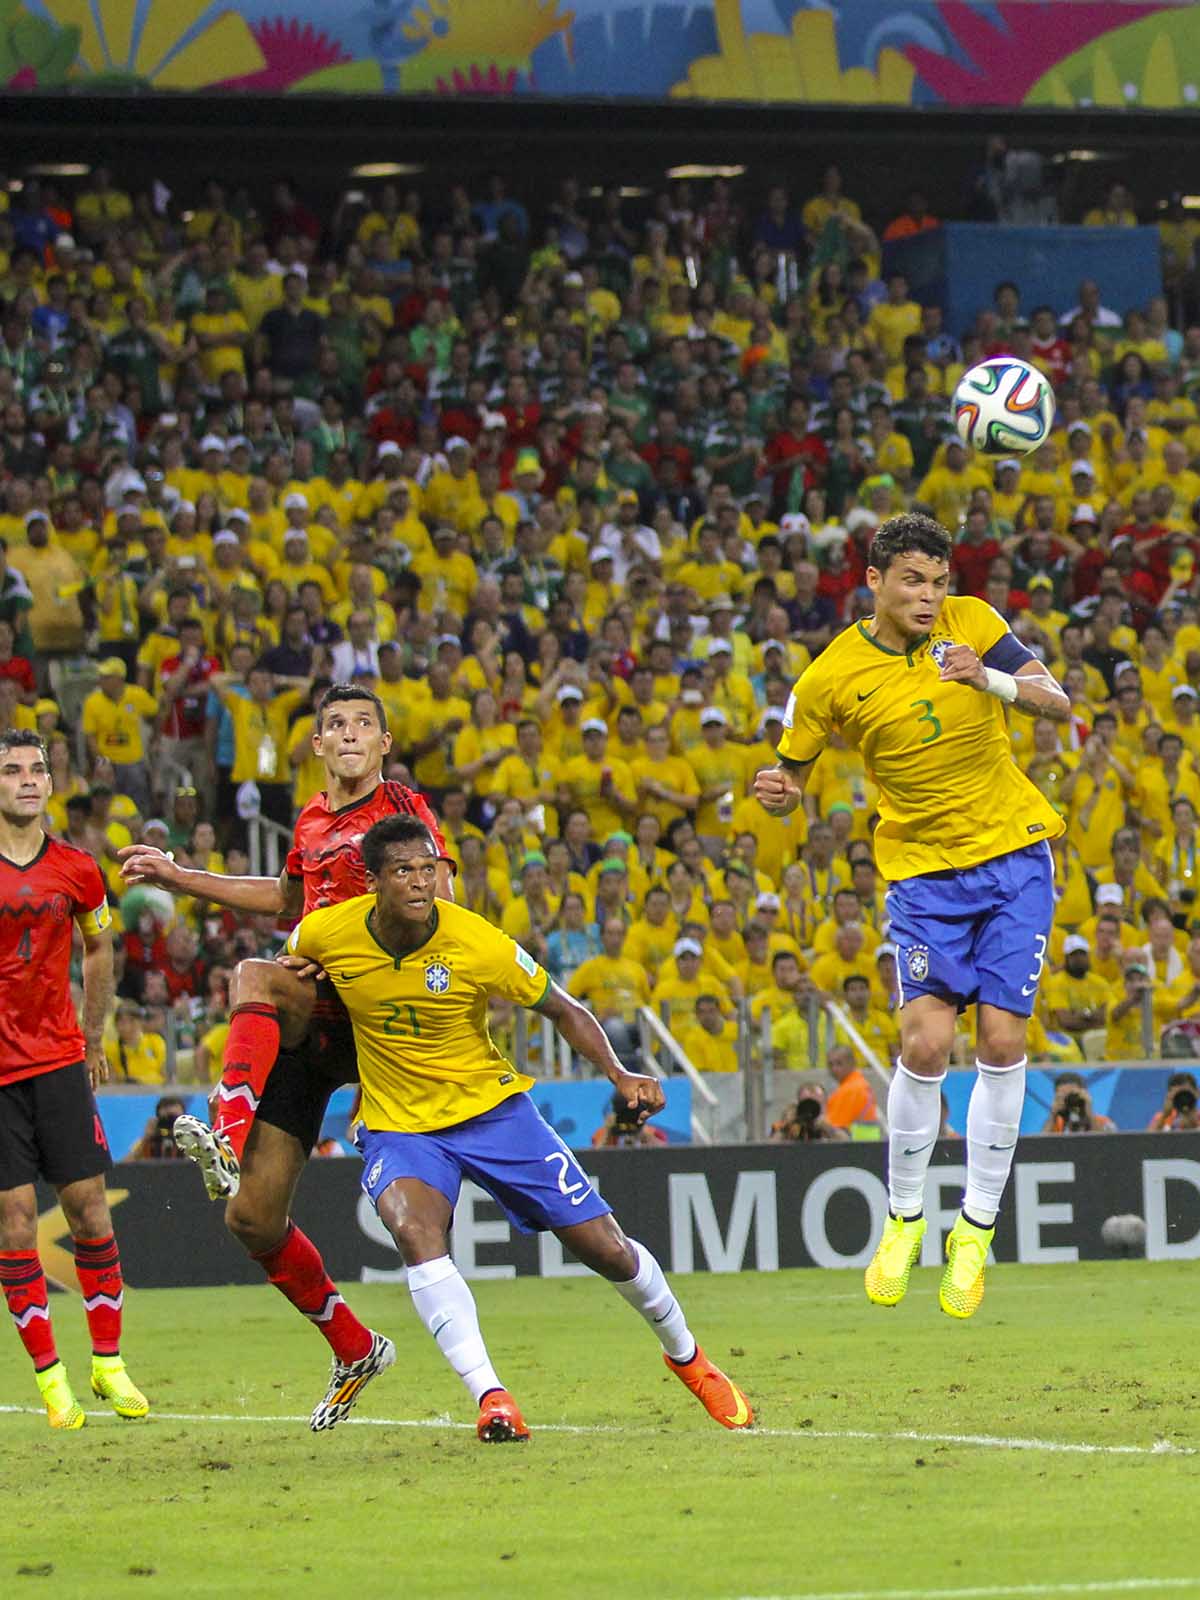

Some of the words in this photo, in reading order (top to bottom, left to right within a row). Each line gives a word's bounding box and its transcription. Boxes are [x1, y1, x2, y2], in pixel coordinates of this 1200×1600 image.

[910, 699, 942, 744] 3
[16, 928, 32, 964] 4
[1029, 934, 1047, 981] 3
[379, 1001, 421, 1036] 21
[93, 1114, 108, 1151] 4
